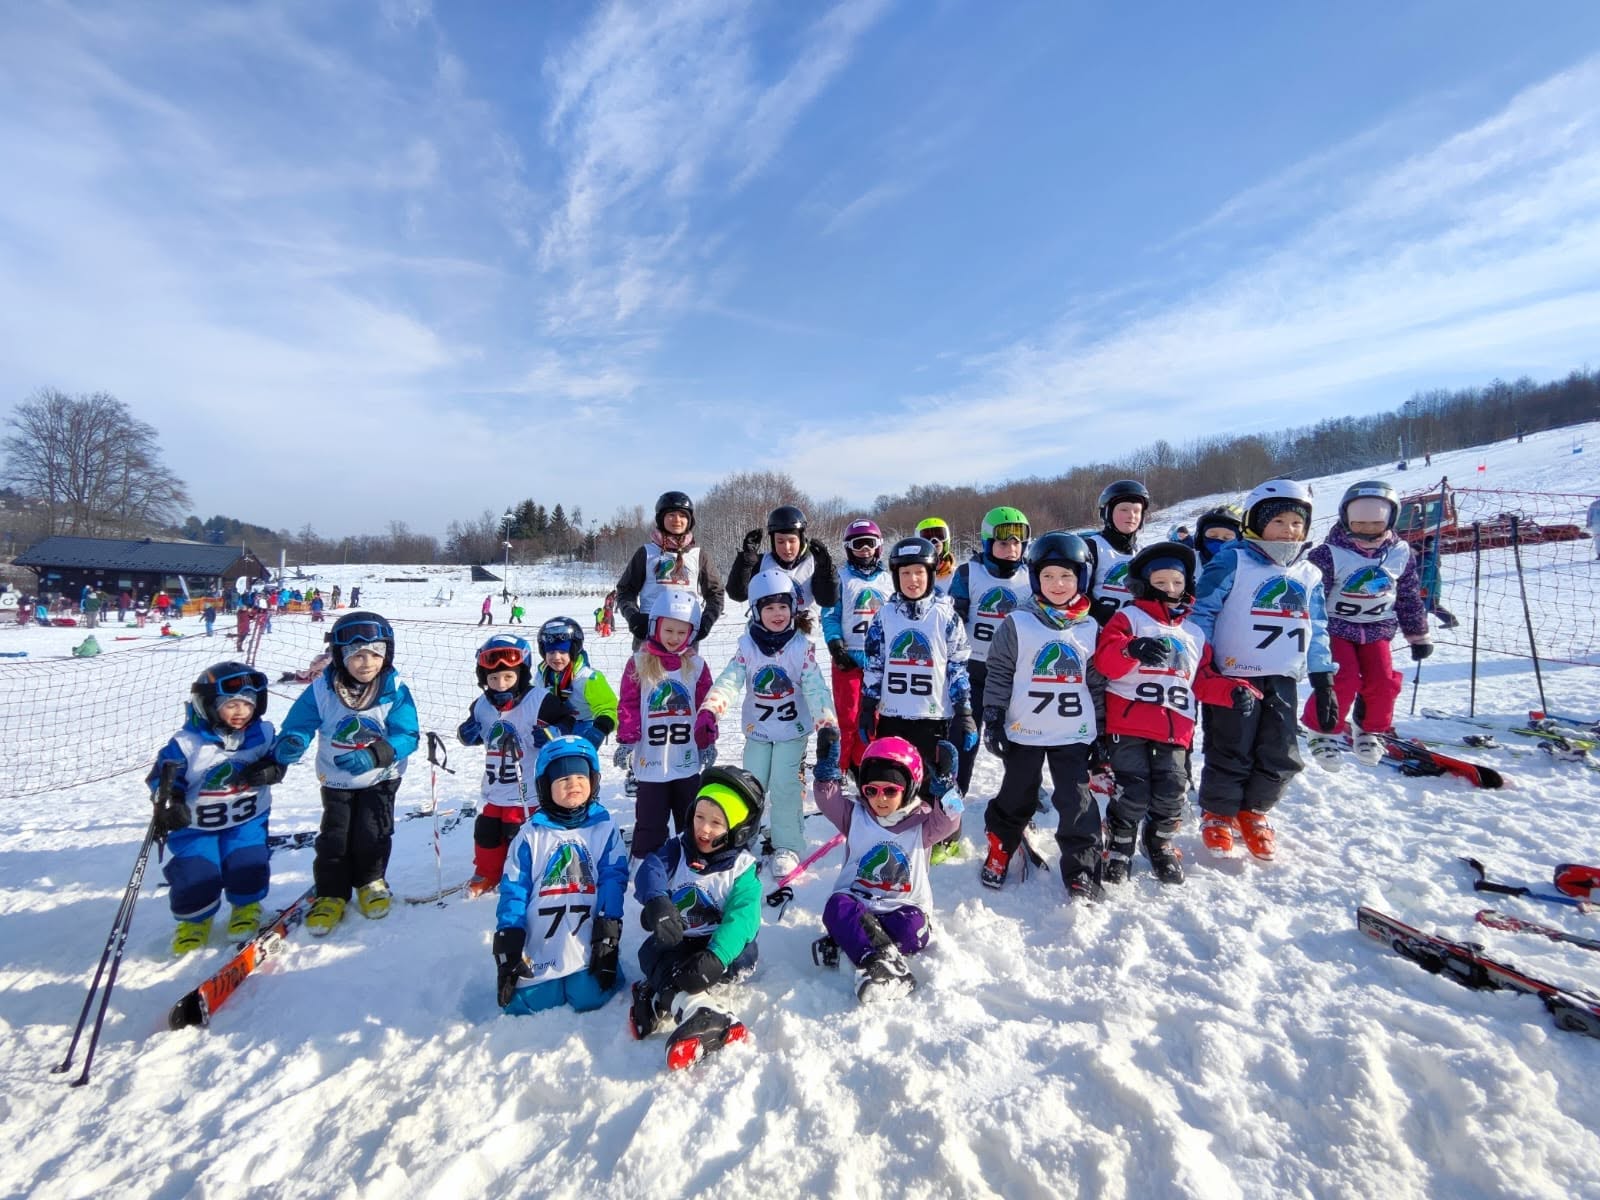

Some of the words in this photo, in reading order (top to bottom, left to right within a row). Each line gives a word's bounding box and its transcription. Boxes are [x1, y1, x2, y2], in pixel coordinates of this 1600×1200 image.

[1335, 601, 1387, 616] 94
[852, 621, 868, 637] 4
[974, 622, 995, 642] 6
[1253, 624, 1305, 653] 71
[888, 672, 932, 696] 55
[1134, 682, 1189, 710] 96
[755, 701, 798, 722] 73
[1028, 691, 1083, 717] 78
[648, 723, 691, 746] 98
[196, 795, 258, 827] 83
[538, 904, 592, 939] 77
